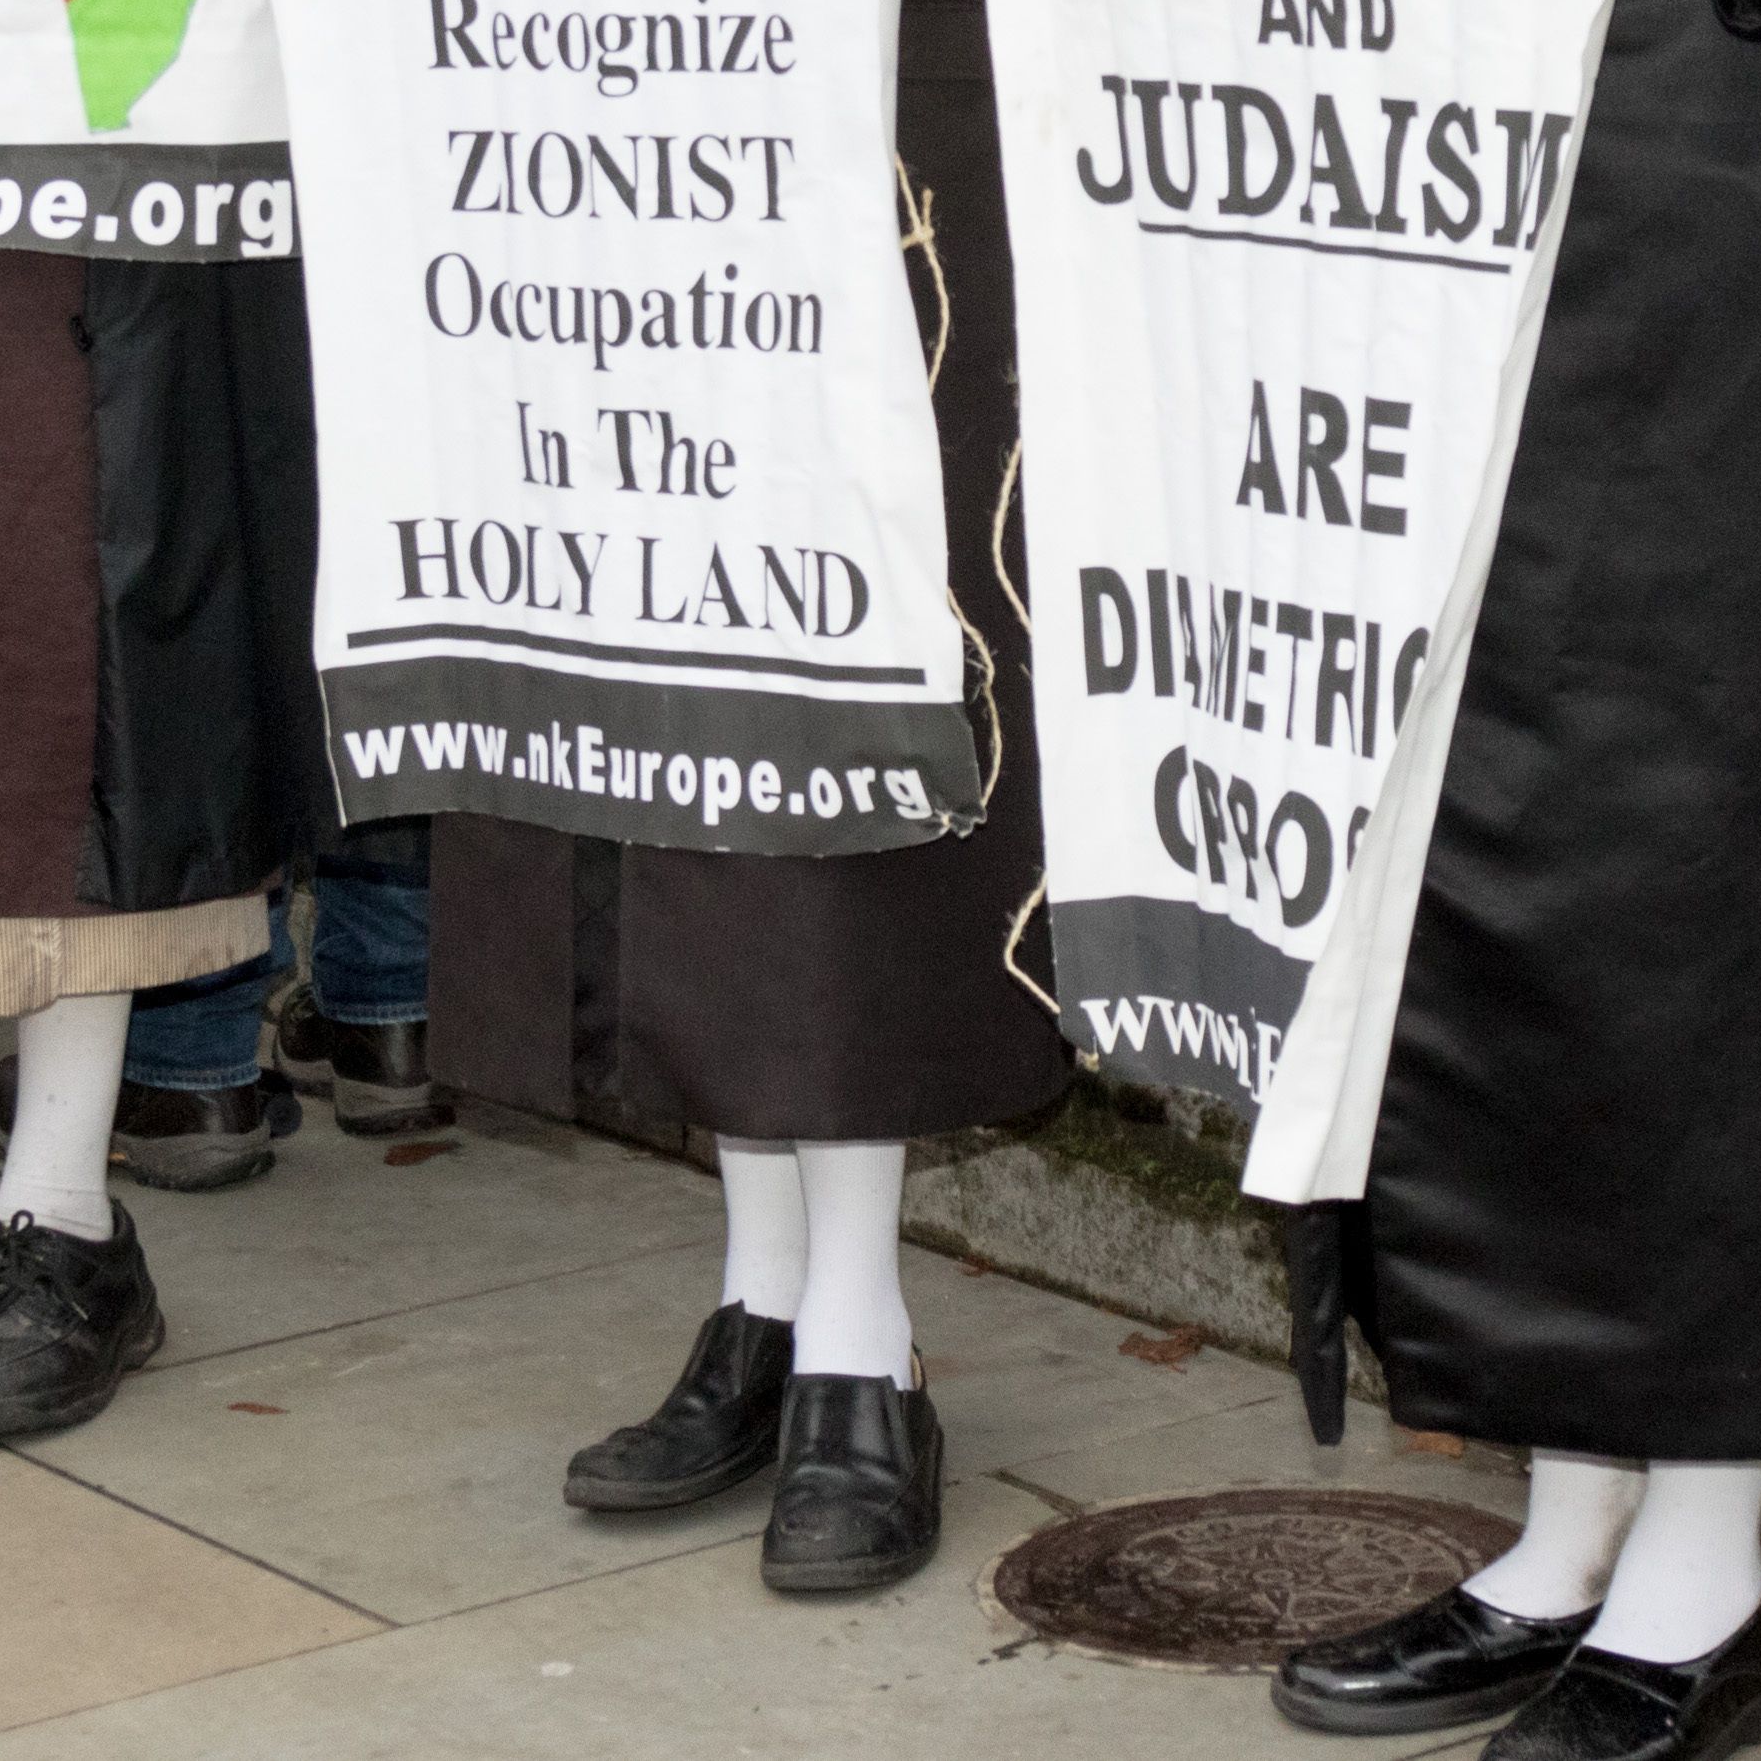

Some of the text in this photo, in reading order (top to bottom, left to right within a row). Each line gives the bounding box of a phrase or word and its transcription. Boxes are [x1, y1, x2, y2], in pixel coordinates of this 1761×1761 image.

[448, 128, 795, 222] ZIONIST
[1076, 75, 1574, 251] JUDAISM
[516, 400, 737, 500] In The
[1236, 378, 1412, 537] ARE
[388, 516, 870, 638] HOLY LAND
[343, 721, 932, 826] www.nkEurope.org
